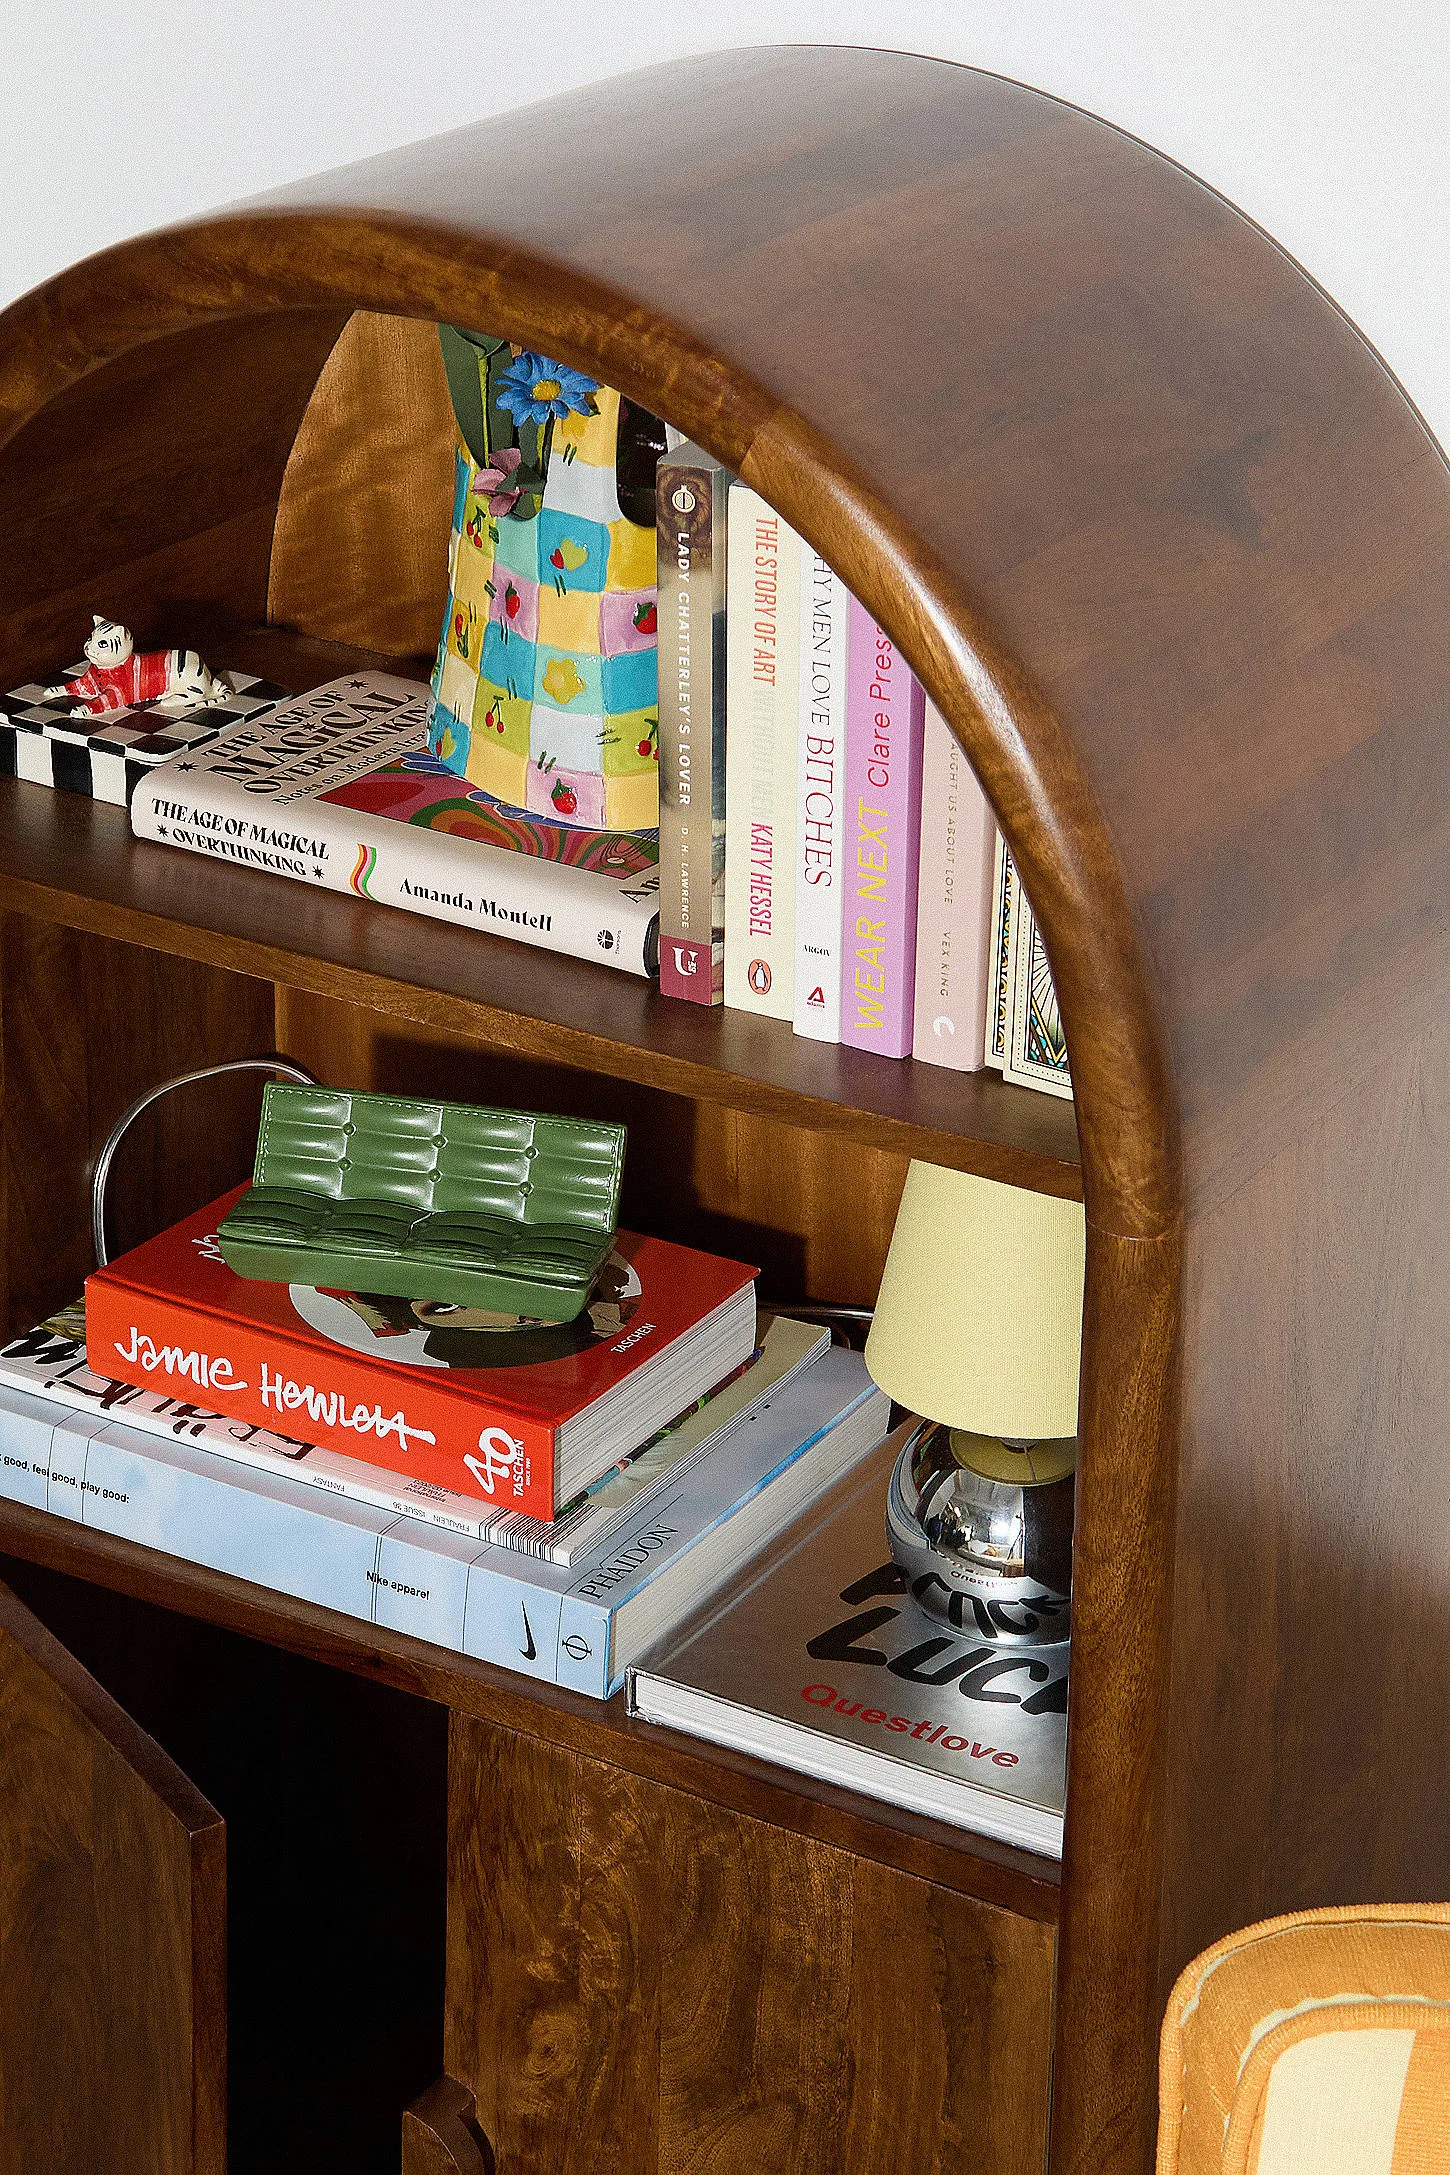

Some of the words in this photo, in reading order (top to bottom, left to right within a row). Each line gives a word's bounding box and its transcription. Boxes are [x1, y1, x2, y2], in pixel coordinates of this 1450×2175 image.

[677, 531, 691, 583] LADY
[755, 518, 779, 554] THE
[753, 556, 778, 619] STORY
[813, 556, 833, 592] HY
[753, 621, 777, 647] OF
[812, 598, 832, 653] MEN
[678, 591, 692, 735] CHATTERLEY'S
[752, 648, 777, 688] ART
[810, 661, 832, 727] LOVE
[201, 731, 267, 758] THE
[258, 706, 318, 736] AGE
[308, 690, 348, 709] OF
[204, 691, 418, 783] MAGICAL
[867, 712, 891, 788] Clare
[271, 784, 322, 806] Notes
[323, 775, 346, 786] on
[340, 747, 402, 776] Modern
[679, 741, 692, 806] LOVER
[949, 742, 959, 791] AUGHT
[151, 798, 189, 823] THE
[188, 808, 222, 832] AGE
[224, 818, 249, 838] OF
[249, 824, 330, 861] MAGICAL
[803, 734, 836, 888] BITCHES
[947, 795, 957, 813] US
[172, 827, 307, 877] OVERTHINKING
[680, 826, 690, 840] D.
[680, 843, 690, 858] H.
[750, 822, 773, 871] KATY
[856, 796, 889, 903] NEXT
[945, 817, 956, 865] ABOUT
[399, 877, 474, 912] Amanda
[479, 897, 553, 933] Montell
[680, 861, 691, 929] LAWRENCE
[749, 871, 773, 937] HESSEL
[944, 868, 955, 905] LOVE
[941, 930, 951, 958] VEX
[853, 915, 888, 1029] WEAR
[939, 963, 950, 997] KING
[610, 1322, 657, 1354] TASCHEN
[3, 1456, 30, 1473] good,
[32, 1463, 50, 1478] feel
[51, 1471, 79, 1489] good,
[80, 1480, 101, 1497] play
[102, 1487, 130, 1504] good:
[312, 1476, 346, 1494] FANTASY
[463, 1426, 517, 1495] 40
[511, 1438, 525, 1498] TASCHEN
[365, 1570, 389, 1588] Nike
[390, 1580, 430, 1601] apparel
[577, 1523, 679, 1600] PHAIDON
[800, 1683, 1020, 1768] Questlove
